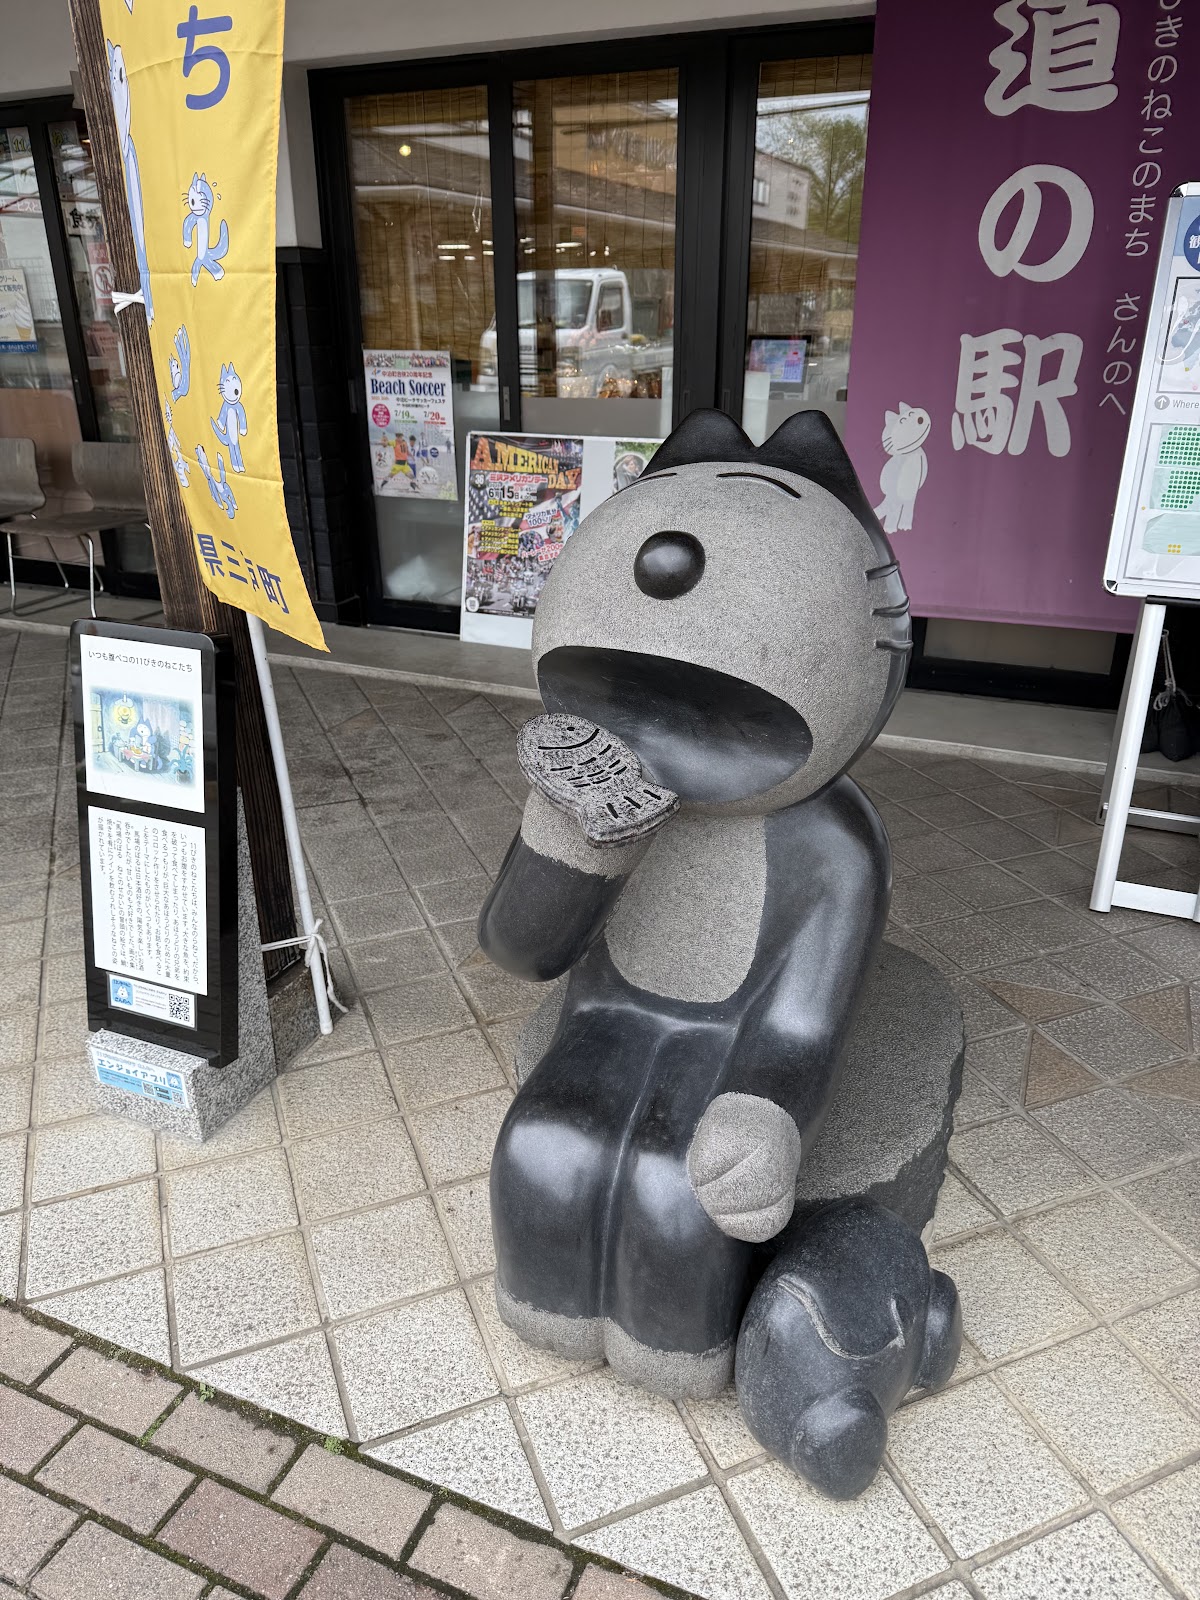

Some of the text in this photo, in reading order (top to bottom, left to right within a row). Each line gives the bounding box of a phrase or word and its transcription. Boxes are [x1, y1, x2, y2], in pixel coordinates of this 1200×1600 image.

[176, 4, 233, 111] ち
[952, 0, 1120, 457] 道の駅
[1099, 292, 1141, 415] さんのへ
[371, 378, 446, 397] Beach Soccer
[1173, 400, 1199, 409] Where
[470, 437, 559, 474] AMERICAN
[548, 468, 581, 490] DAY
[98, 1058, 167, 1086] エンジョイアプリ
